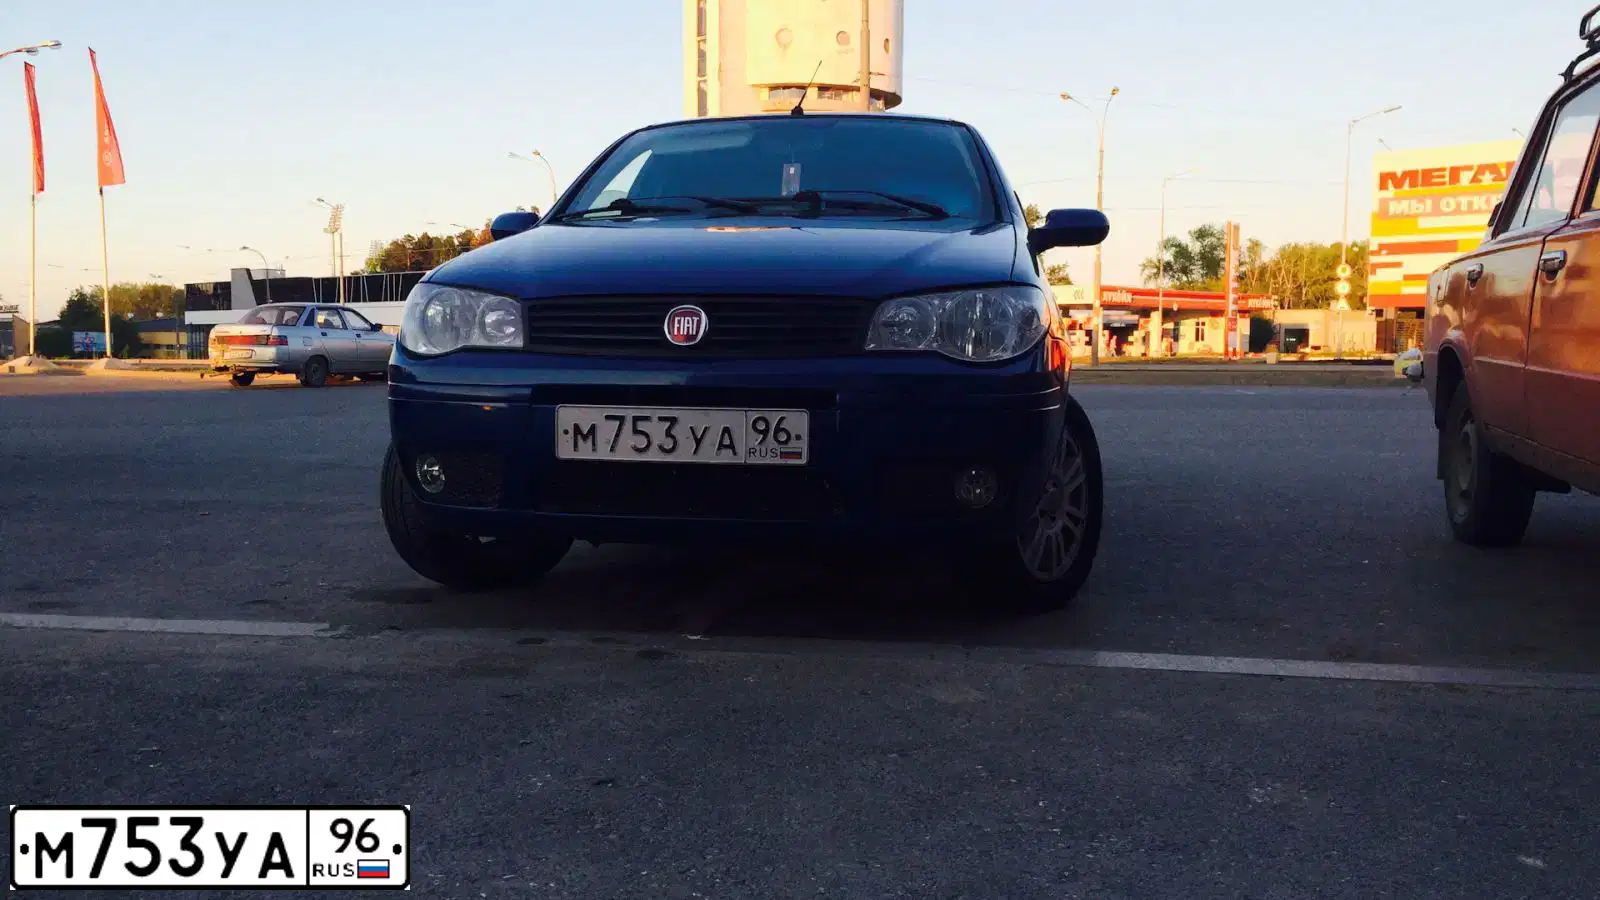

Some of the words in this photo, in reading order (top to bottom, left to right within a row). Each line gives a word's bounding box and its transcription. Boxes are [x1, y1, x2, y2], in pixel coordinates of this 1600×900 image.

[1388, 198, 1433, 216] МЫ
[674, 316, 700, 336] FIAT
[751, 415, 792, 446] 96
[748, 447, 779, 459] RUS
